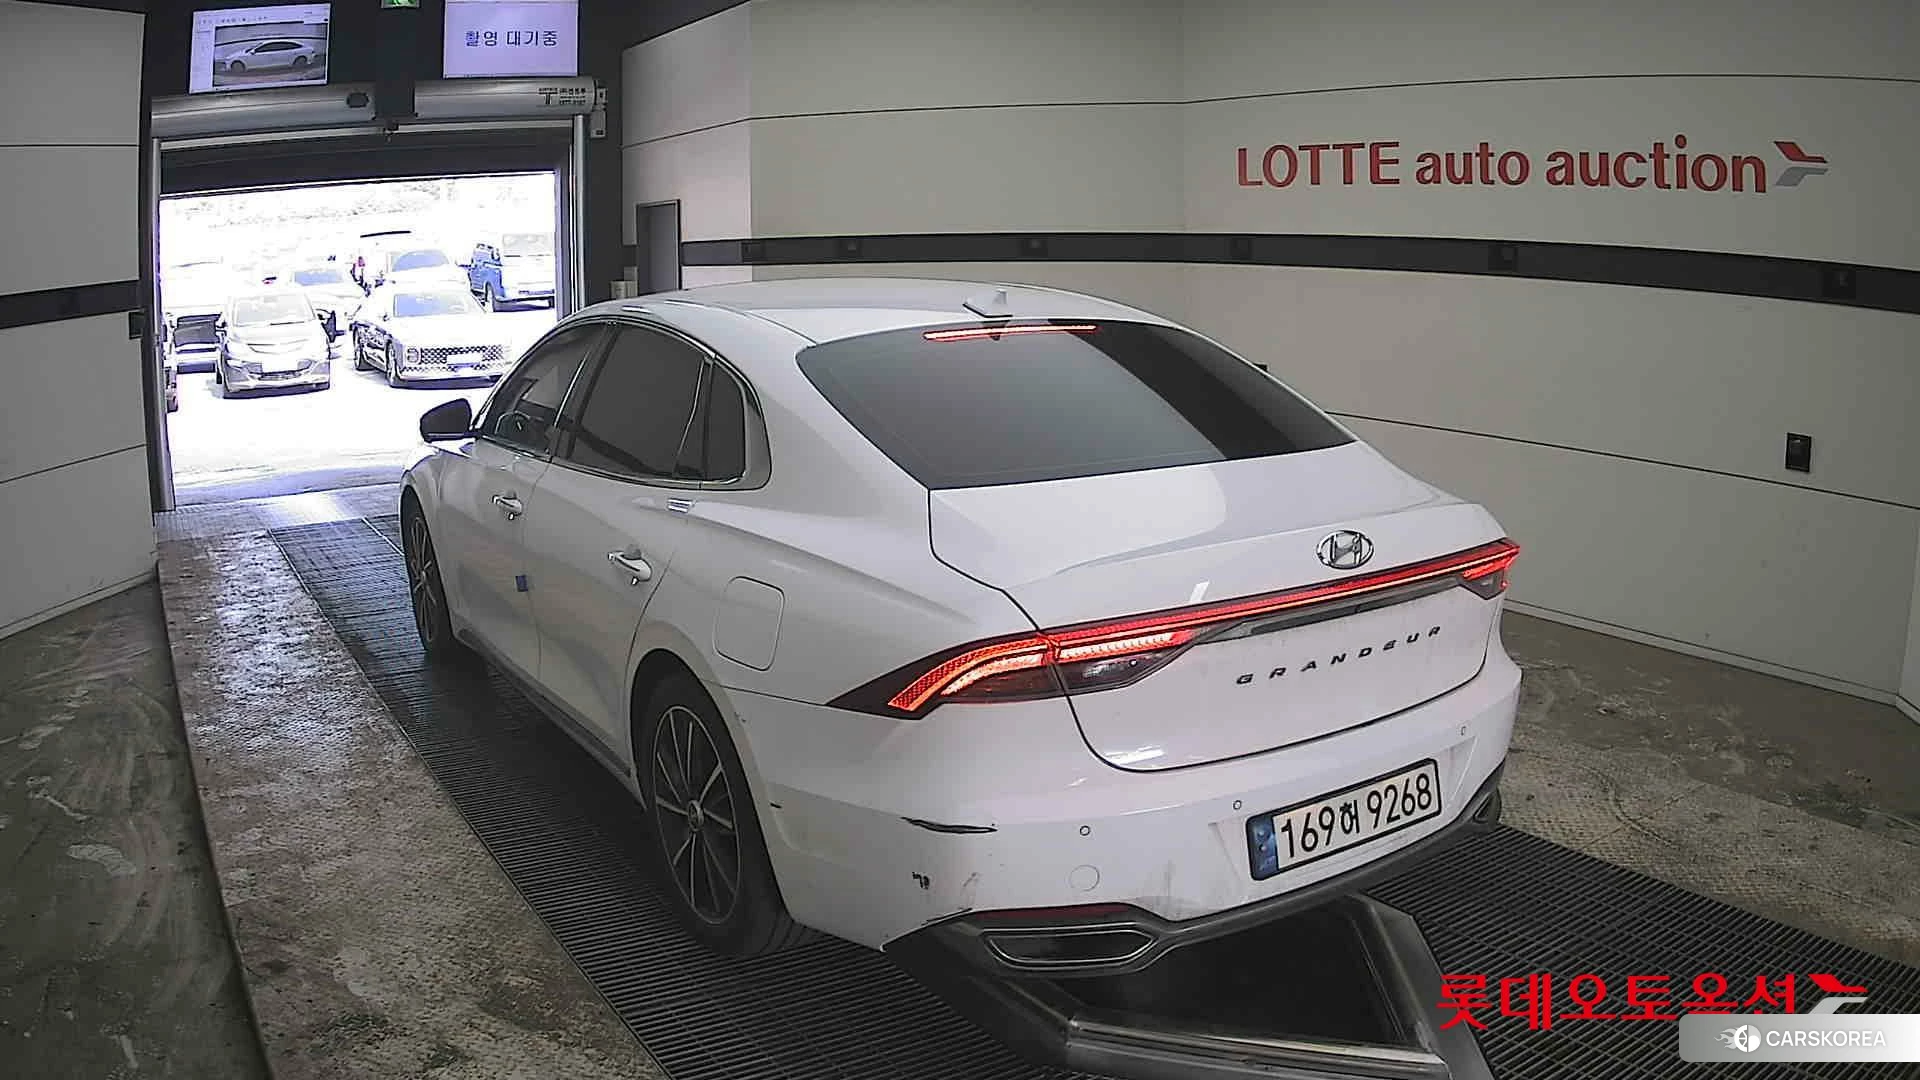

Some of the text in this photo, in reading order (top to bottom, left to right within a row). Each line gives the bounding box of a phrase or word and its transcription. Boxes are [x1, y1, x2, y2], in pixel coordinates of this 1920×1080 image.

[506, 30, 558, 47] 대기중
[1237, 134, 1768, 193] LOTTE auto auction
[1236, 626, 1441, 685] GRANDEUR
[1281, 773, 1432, 858] 169허 9268
